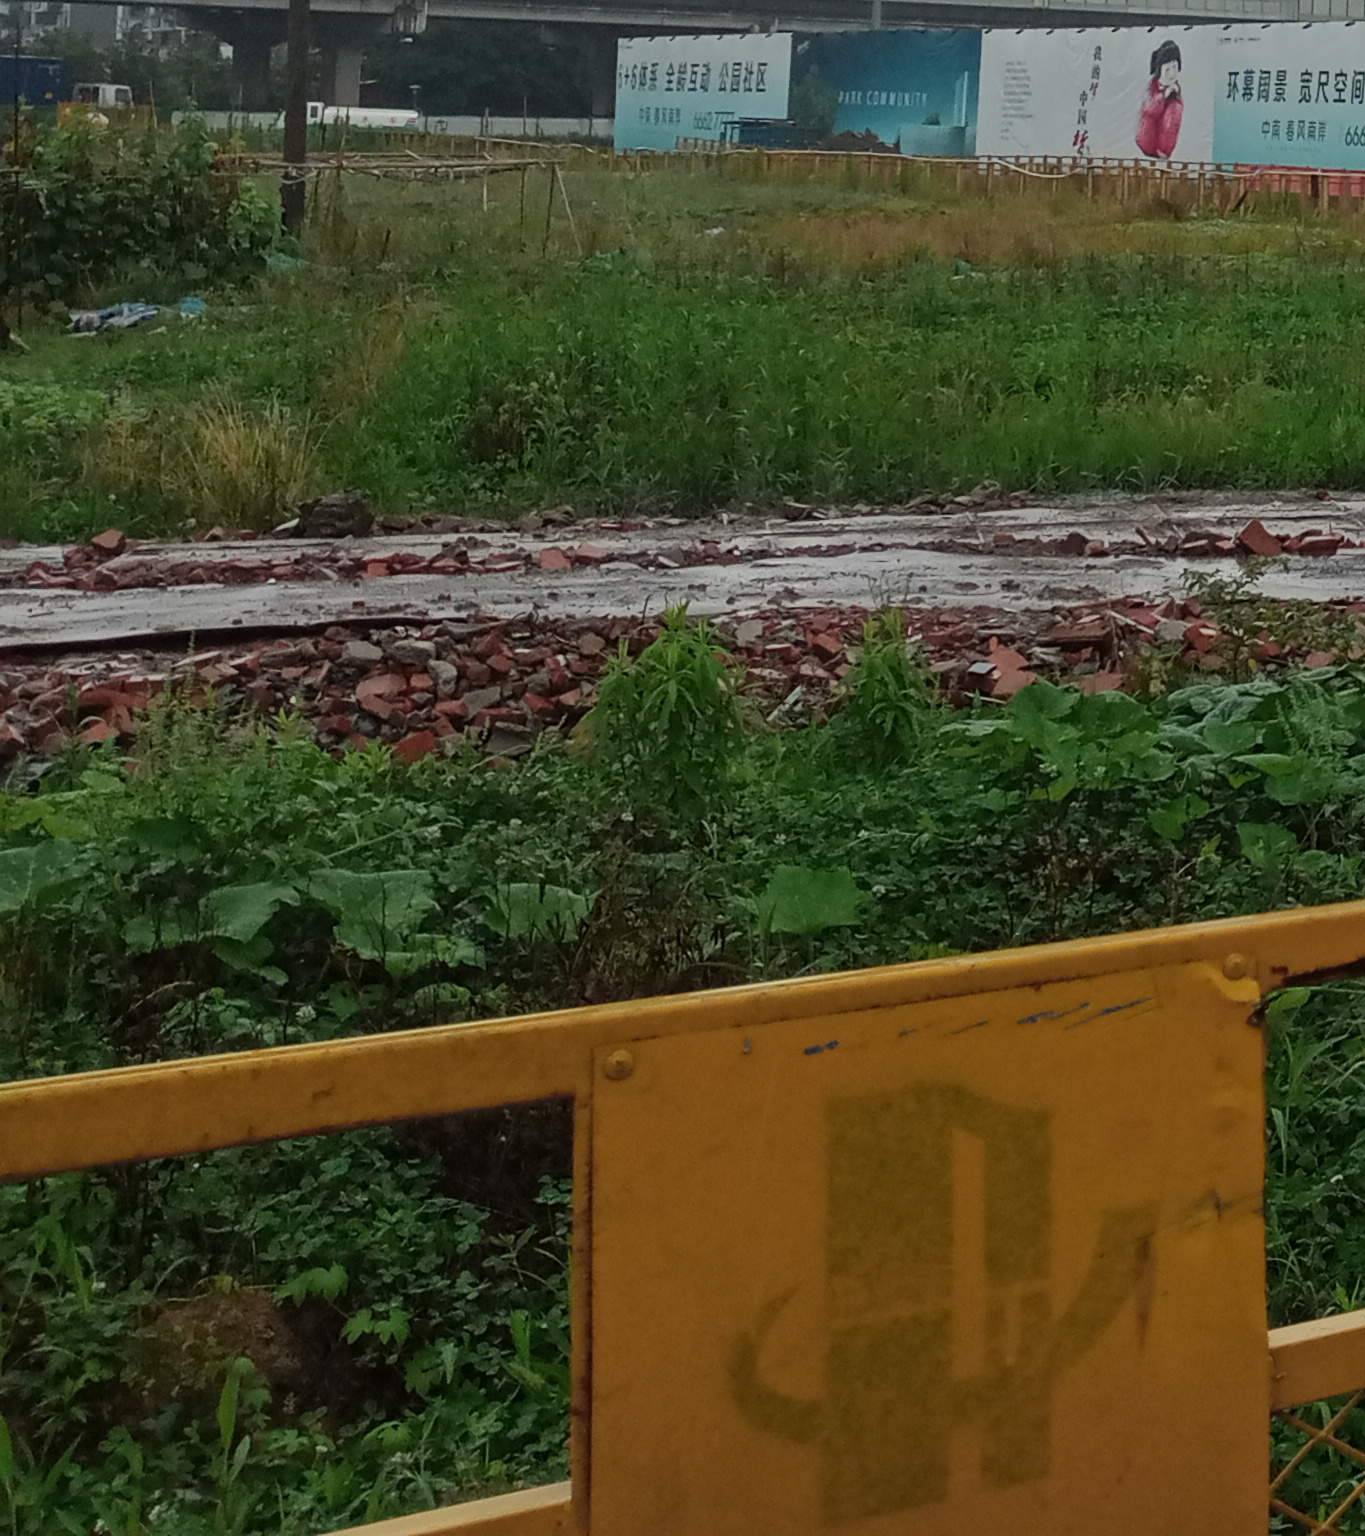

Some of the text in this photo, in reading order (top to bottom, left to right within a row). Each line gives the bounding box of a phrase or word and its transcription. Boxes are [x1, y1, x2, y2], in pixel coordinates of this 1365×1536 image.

[718, 62, 768, 92] 公园社区
[1226, 69, 1288, 104] 环幕阔景
[1298, 69, 1365, 105] 宽尺空间
[838, 90, 928, 107] PARK COMMUNITY
